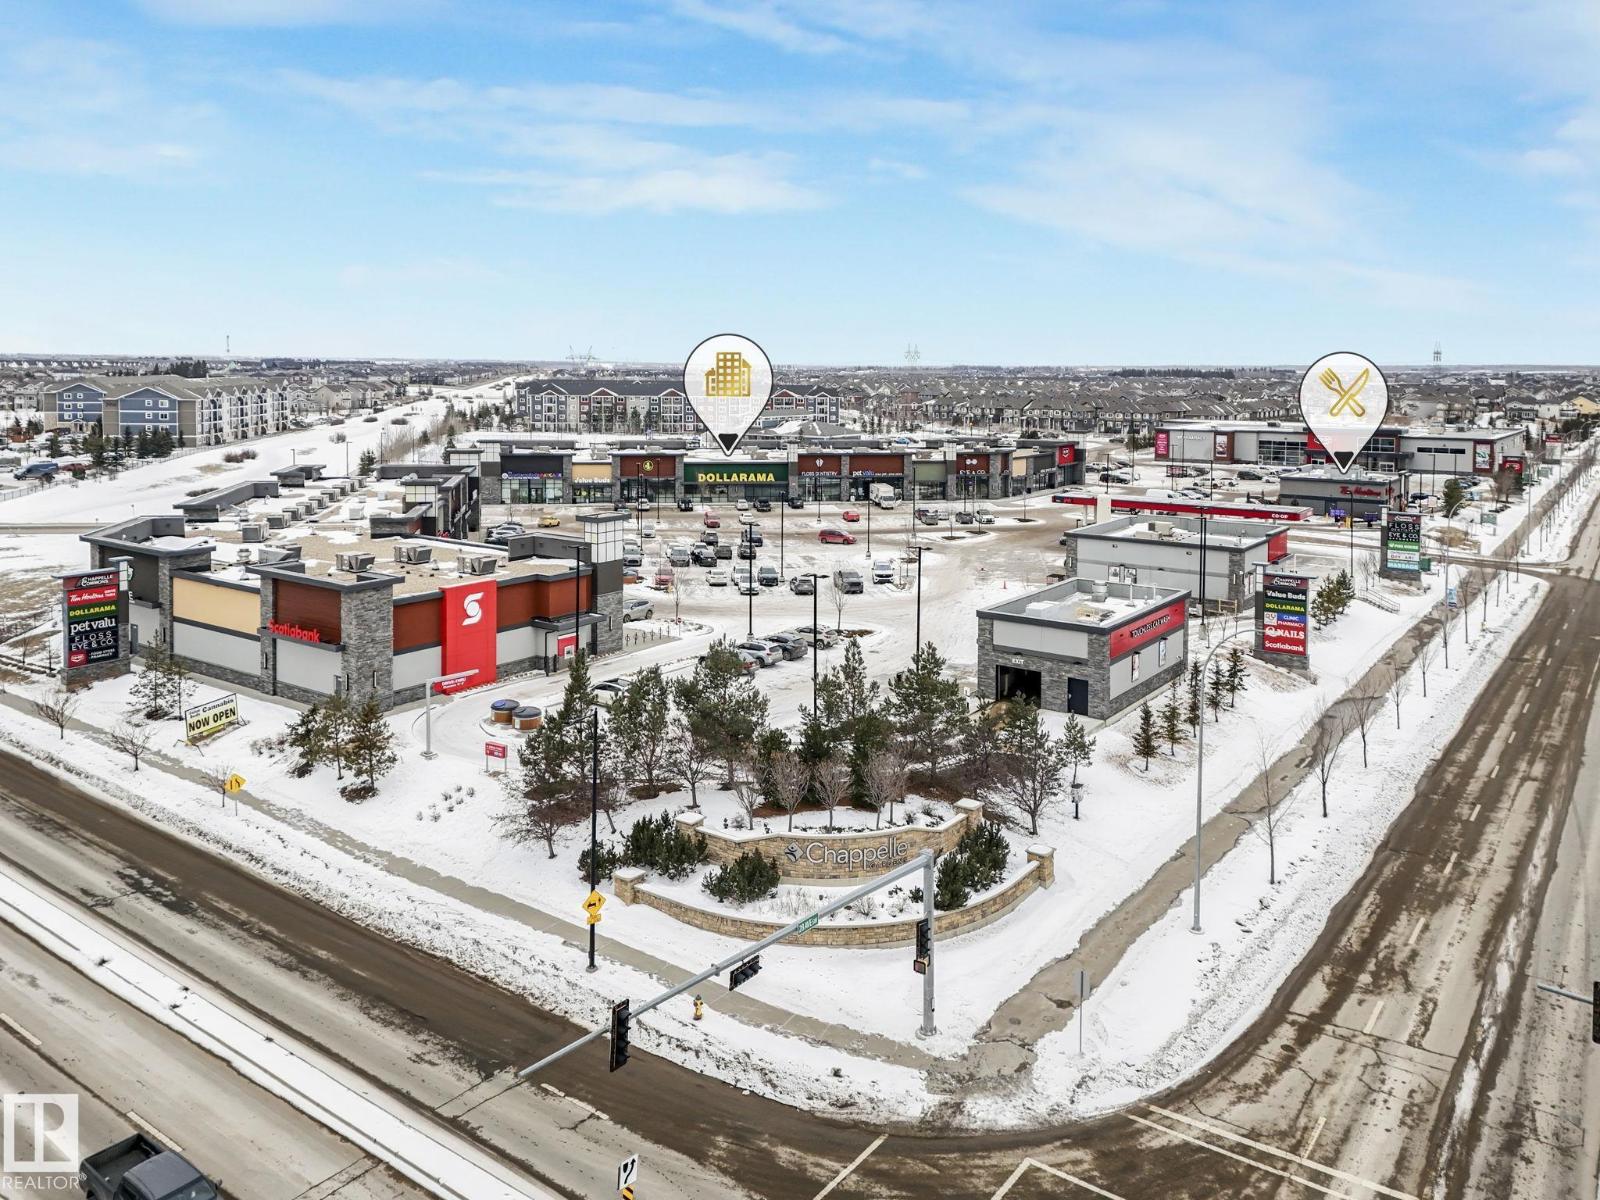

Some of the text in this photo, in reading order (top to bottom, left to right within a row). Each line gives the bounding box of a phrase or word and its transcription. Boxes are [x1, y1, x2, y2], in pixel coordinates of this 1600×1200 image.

[698, 473, 775, 482] DOLLARAMA
[852, 470, 863, 478] pet
[1388, 522, 1420, 530] FLOSS
[69, 594, 81, 602] Tim
[1266, 590, 1306, 600] Value Buds
[69, 604, 116, 617] DOLLARAMA
[1265, 603, 1305, 612] DOLLARAMA
[70, 617, 116, 636] pet valu
[1277, 620, 1305, 628] PHARMACY
[75, 630, 112, 643] FLOSS
[268, 619, 320, 643] Scotiabank
[71, 642, 88, 651] EYE
[91, 640, 97, 648] &
[1265, 640, 1305, 652] Scotiabank
[202, 698, 234, 713] Cannabis
[188, 715, 210, 732] NOW
[212, 706, 236, 723] OPEN
[806, 836, 909, 871] Chappelle
